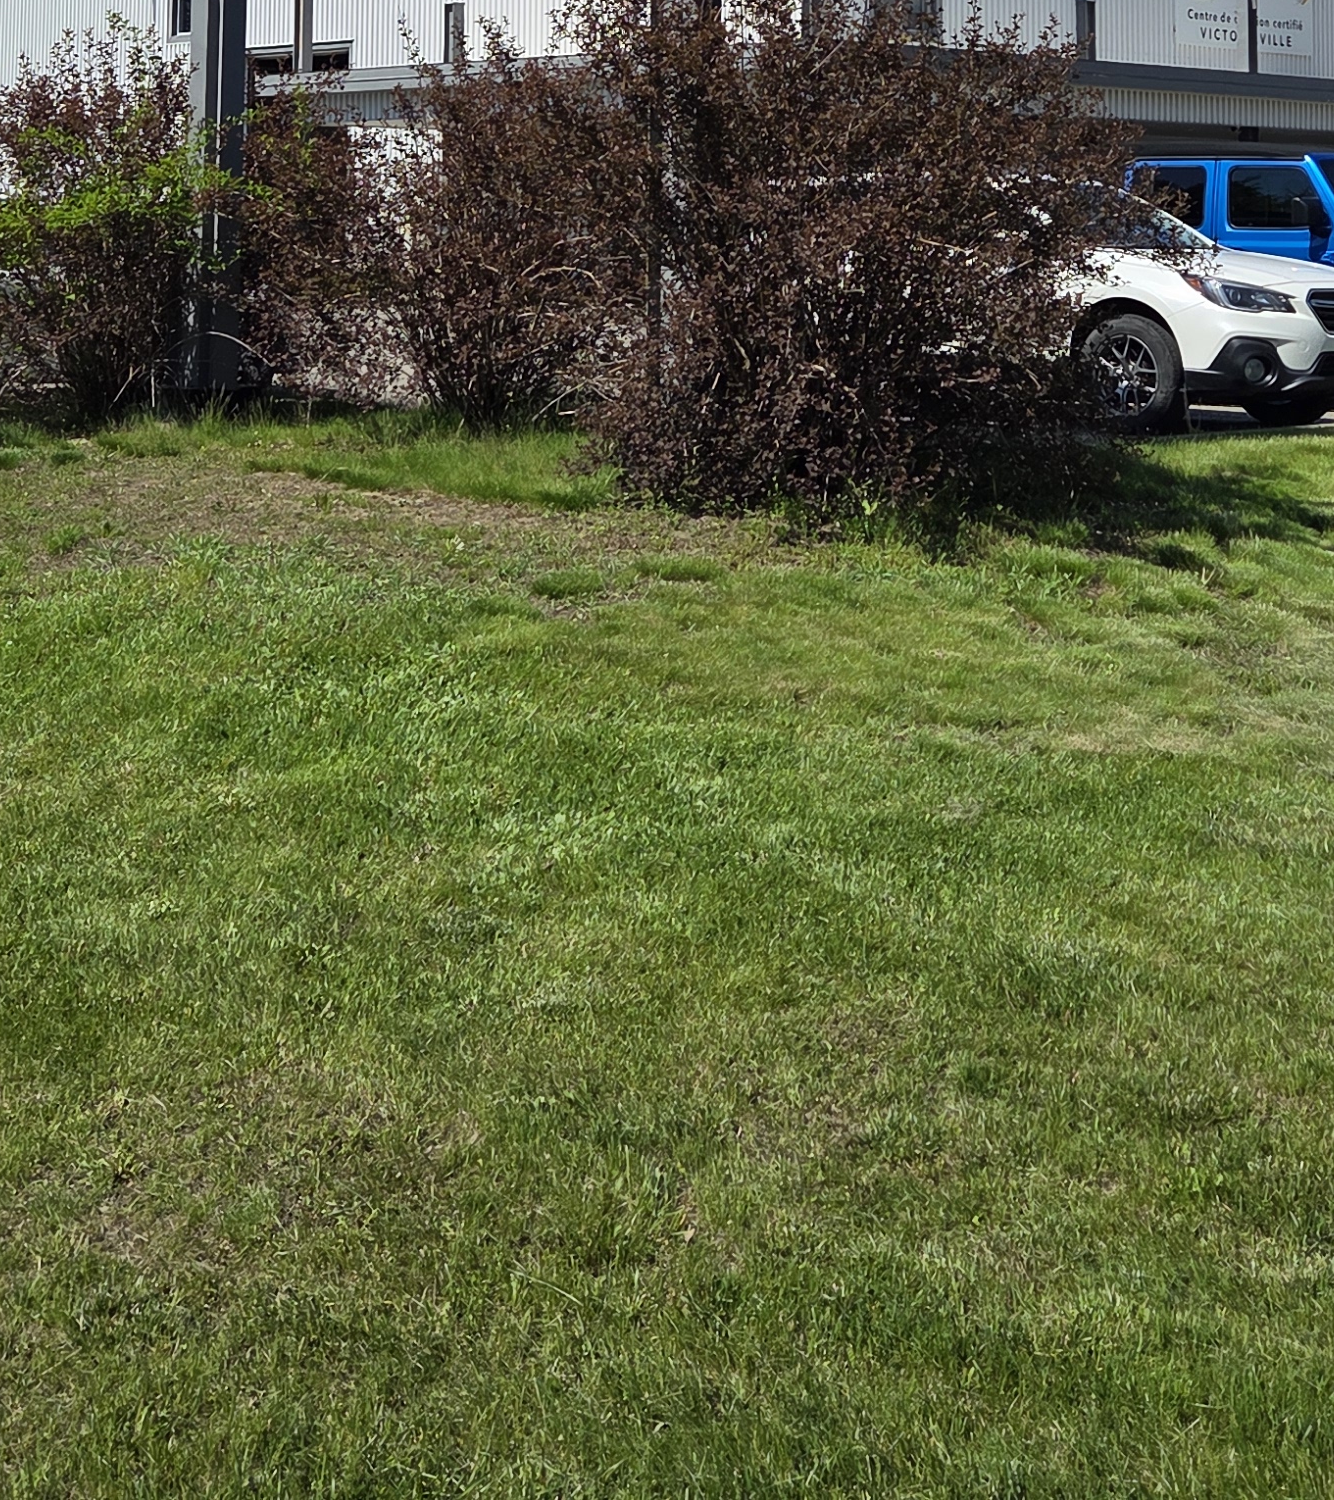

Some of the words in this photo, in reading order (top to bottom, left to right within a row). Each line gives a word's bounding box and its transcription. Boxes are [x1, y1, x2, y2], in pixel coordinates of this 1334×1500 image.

[1187, 8, 1218, 22] Centre
[1219, 11, 1231, 24] de
[1199, 26, 1293, 48] VICTOVILLE
